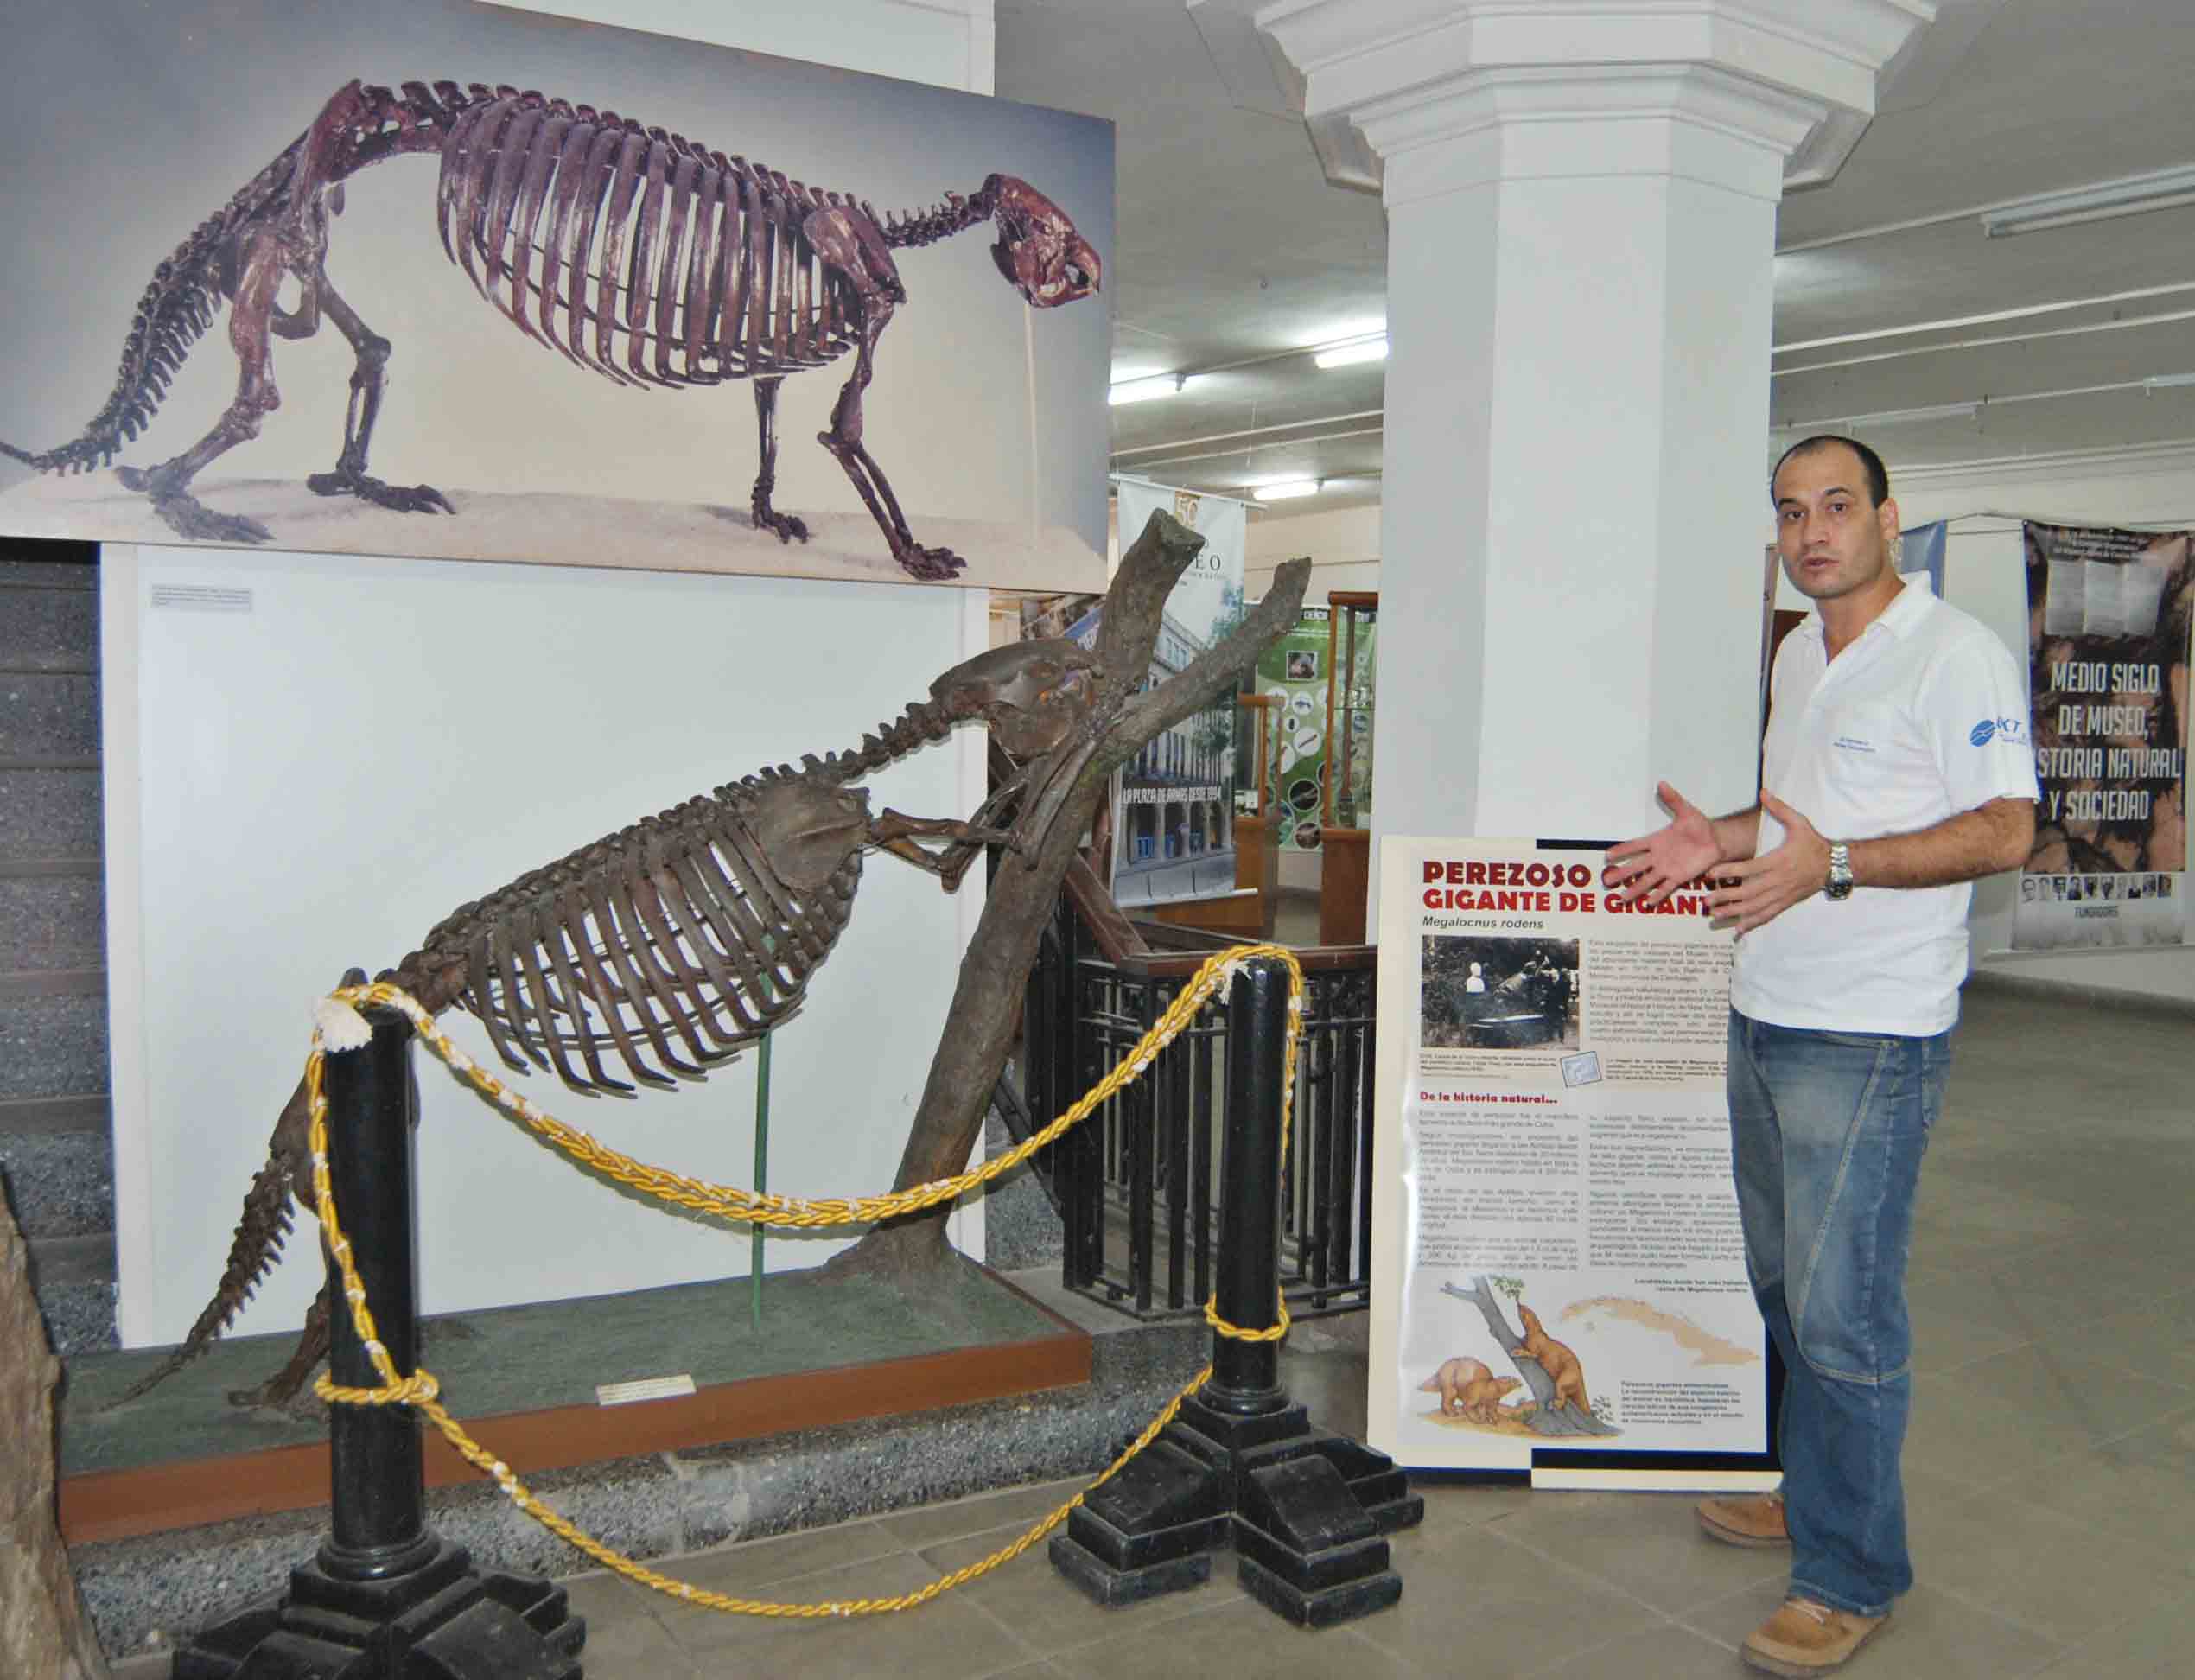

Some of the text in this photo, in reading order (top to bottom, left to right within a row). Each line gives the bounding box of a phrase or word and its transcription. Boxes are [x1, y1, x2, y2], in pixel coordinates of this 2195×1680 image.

[2050, 662, 2160, 693] MEDIO SIGLO
[2058, 704, 2149, 741] DE MUSEO,
[2037, 748, 2183, 778] STORIA NATURAL
[1133, 787, 1157, 805] PLAZA
[2049, 790, 2150, 821] Y SOCIEDAD
[1423, 861, 1592, 888] PEREZOSO
[1422, 888, 1552, 912] GIGANTE
[1559, 891, 1596, 913] DE
[1422, 915, 1544, 930] Megalocnus rodens
[1419, 1091, 1559, 1104] De la historia natural...
